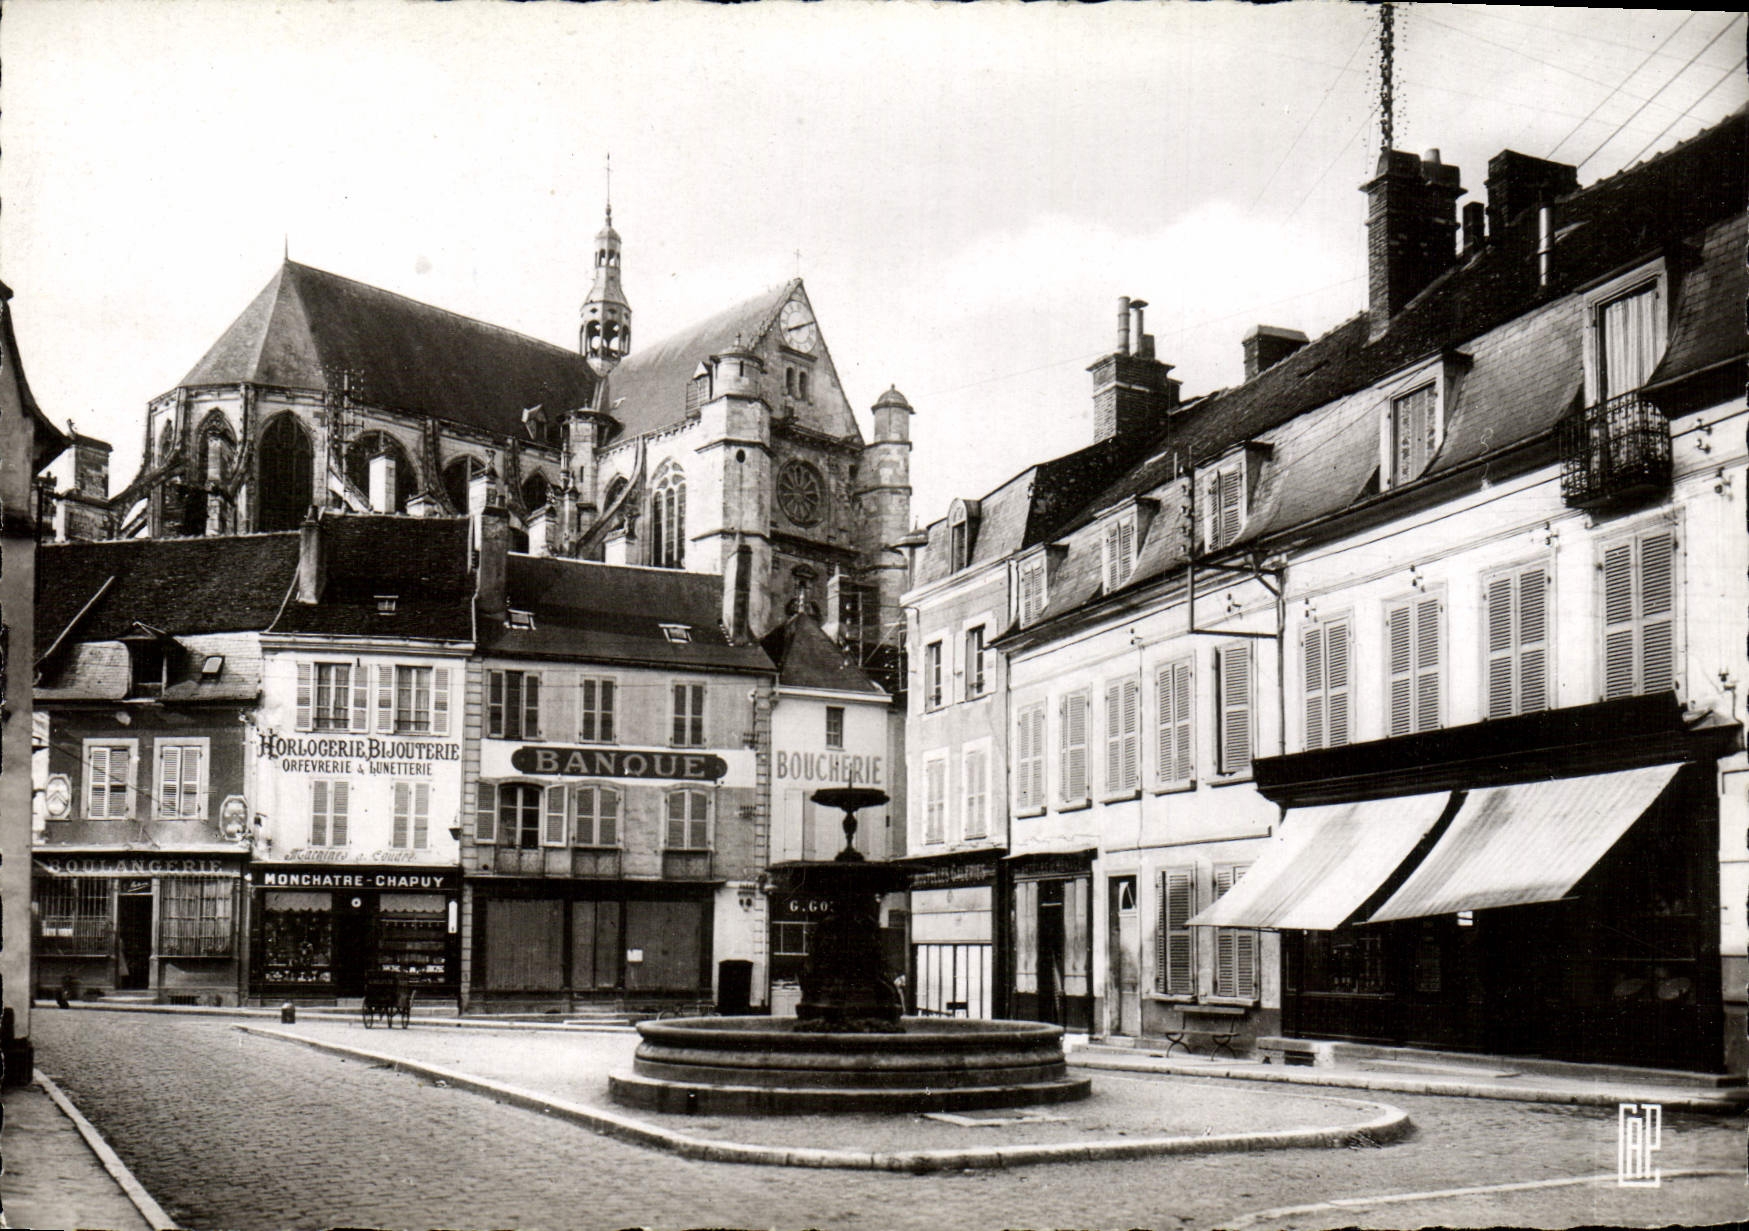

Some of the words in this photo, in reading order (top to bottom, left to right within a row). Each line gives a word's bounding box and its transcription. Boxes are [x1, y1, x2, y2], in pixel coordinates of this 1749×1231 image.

[367, 738, 460, 761] BIJOUTERIE
[282, 758, 351, 774] ORFEVRERIE
[369, 761, 432, 776] LUNETTERIE
[535, 750, 705, 777] BANQUE
[777, 751, 882, 784] BOUCHERIE
[50, 859, 223, 873] BOULANGERIE
